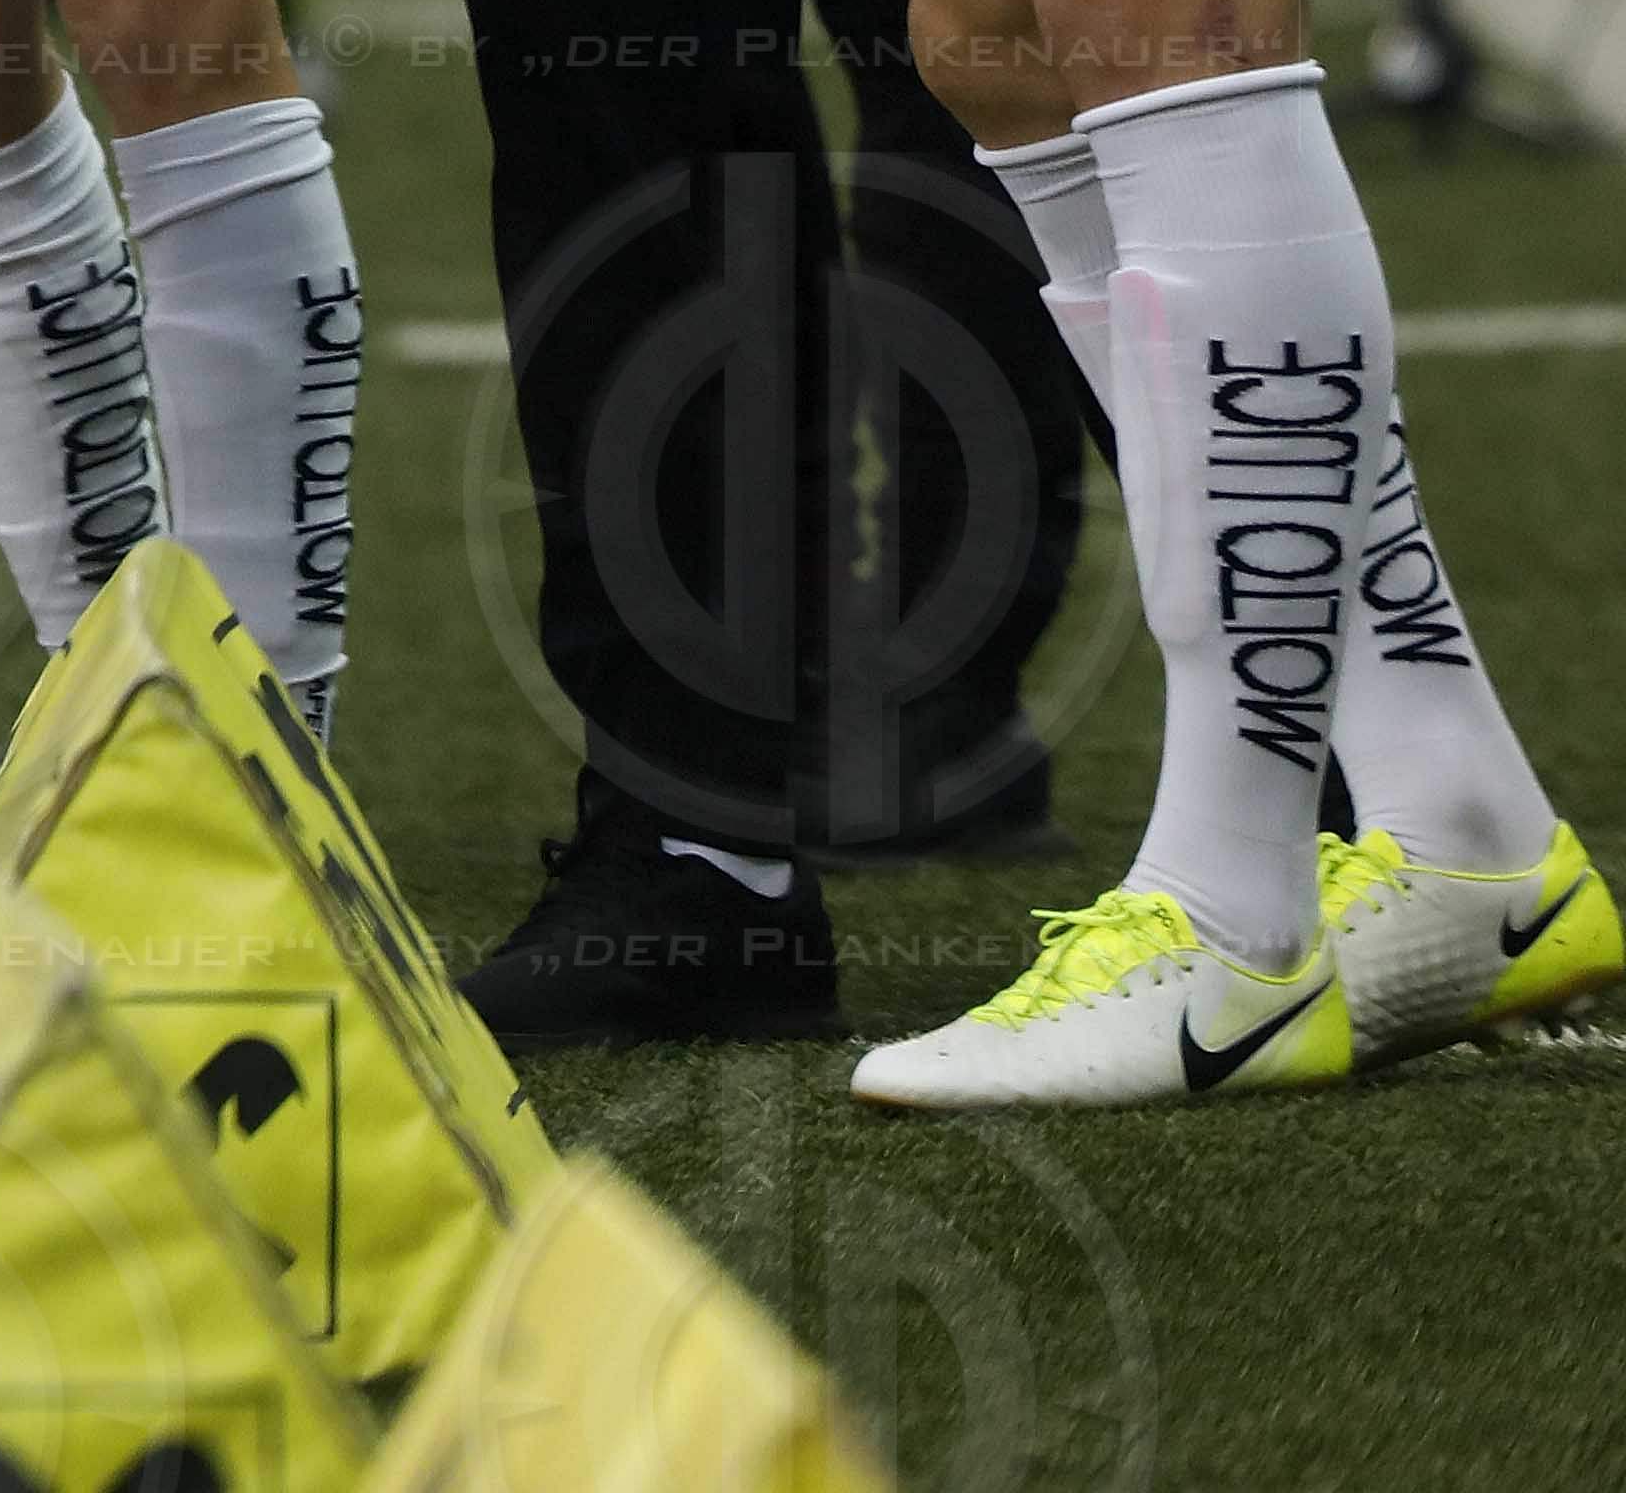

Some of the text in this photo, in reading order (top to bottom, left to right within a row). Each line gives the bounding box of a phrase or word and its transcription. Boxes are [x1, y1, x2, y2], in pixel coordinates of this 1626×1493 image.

[293, 433, 354, 625] MOLTO
[1207, 333, 1364, 772] MOLTO LUCE
